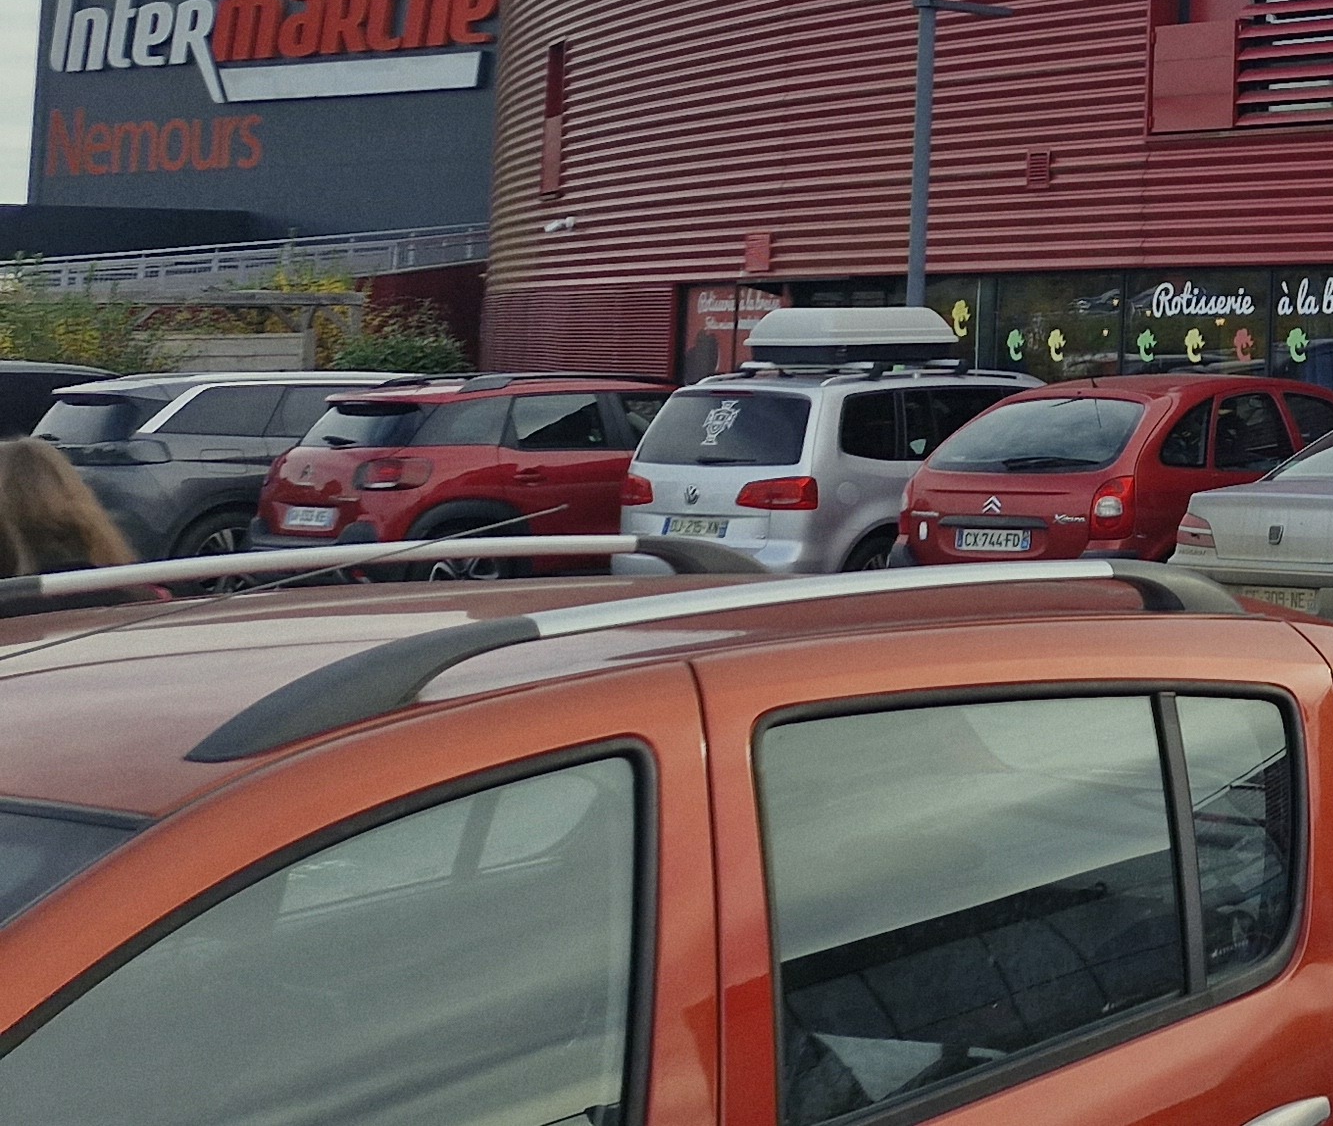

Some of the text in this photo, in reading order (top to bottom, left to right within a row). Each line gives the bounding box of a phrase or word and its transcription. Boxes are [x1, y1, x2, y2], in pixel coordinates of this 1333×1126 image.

[44, 107, 263, 175] Nemours
[1152, 281, 1255, 318] Rotisserie
[1277, 281, 1293, 315] à
[1297, 277, 1319, 315] la
